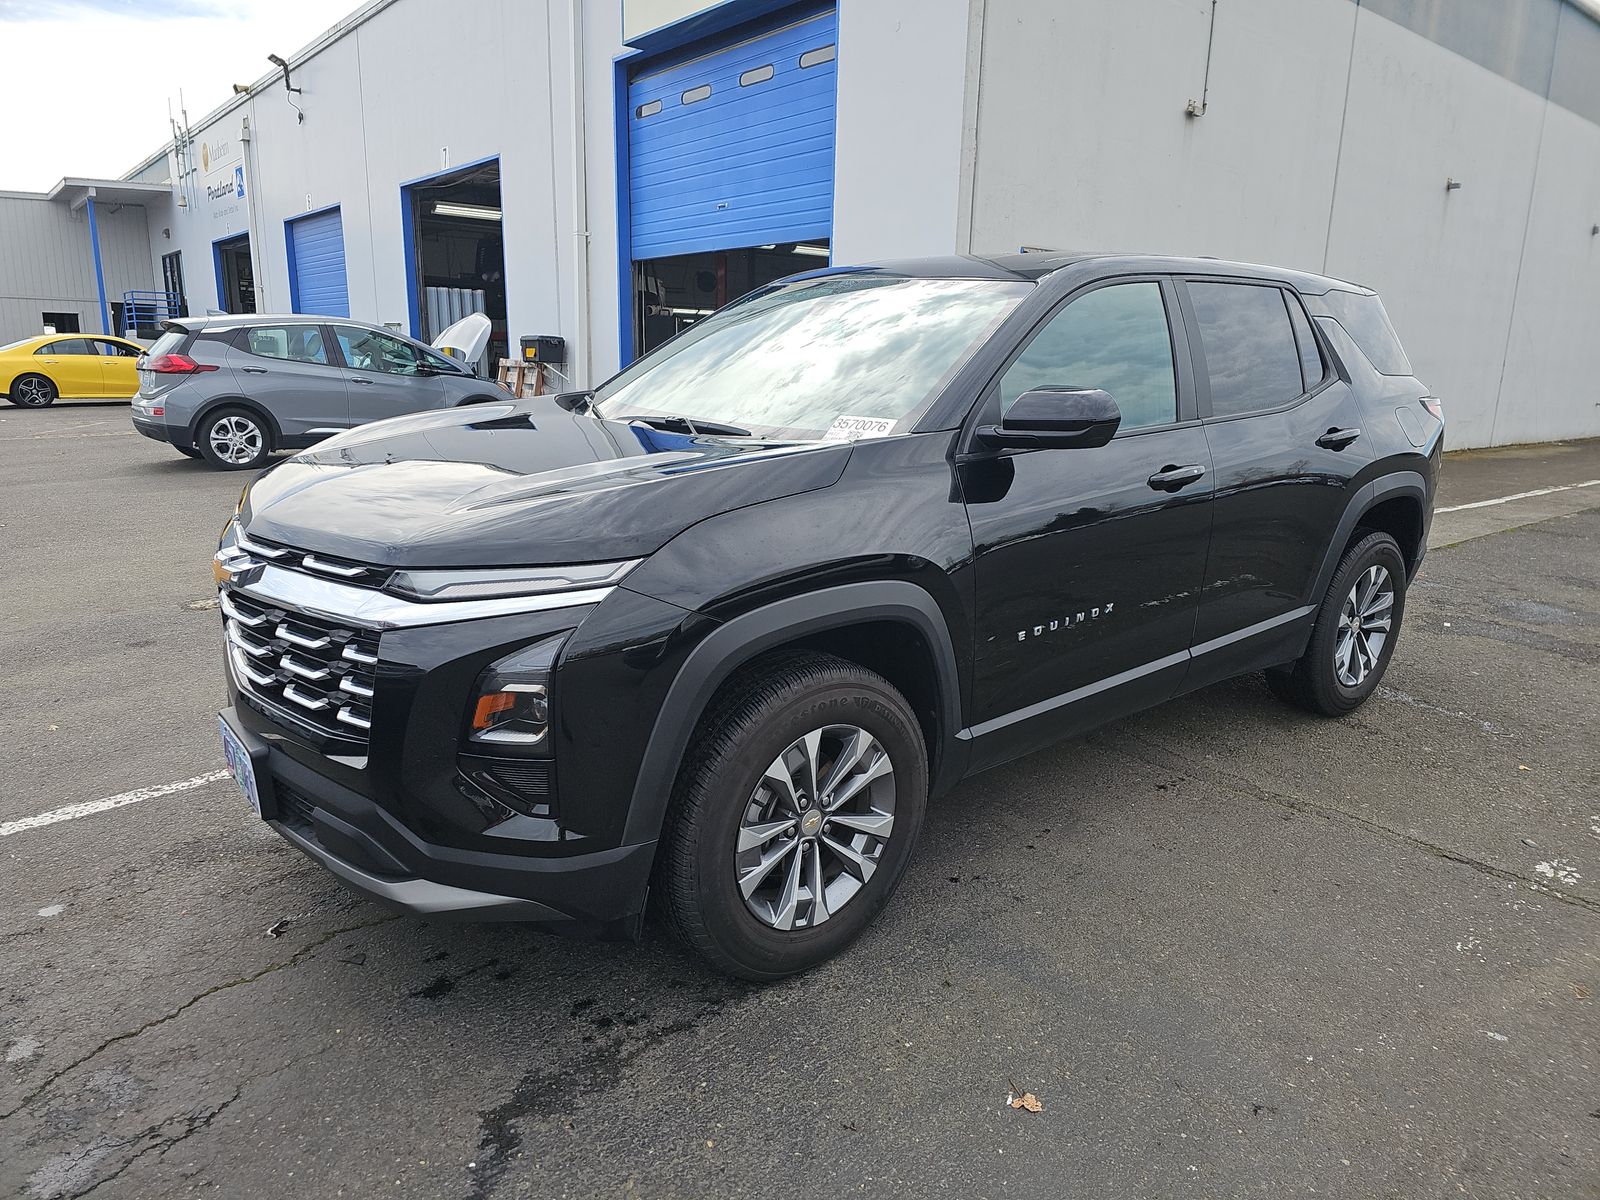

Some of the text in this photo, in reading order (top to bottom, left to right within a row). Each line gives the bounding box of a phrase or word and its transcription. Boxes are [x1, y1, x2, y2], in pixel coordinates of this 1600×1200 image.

[207, 174, 234, 203] Portland
[832, 418, 889, 433] 3570076
[1017, 602, 1114, 642] EQUINOX
